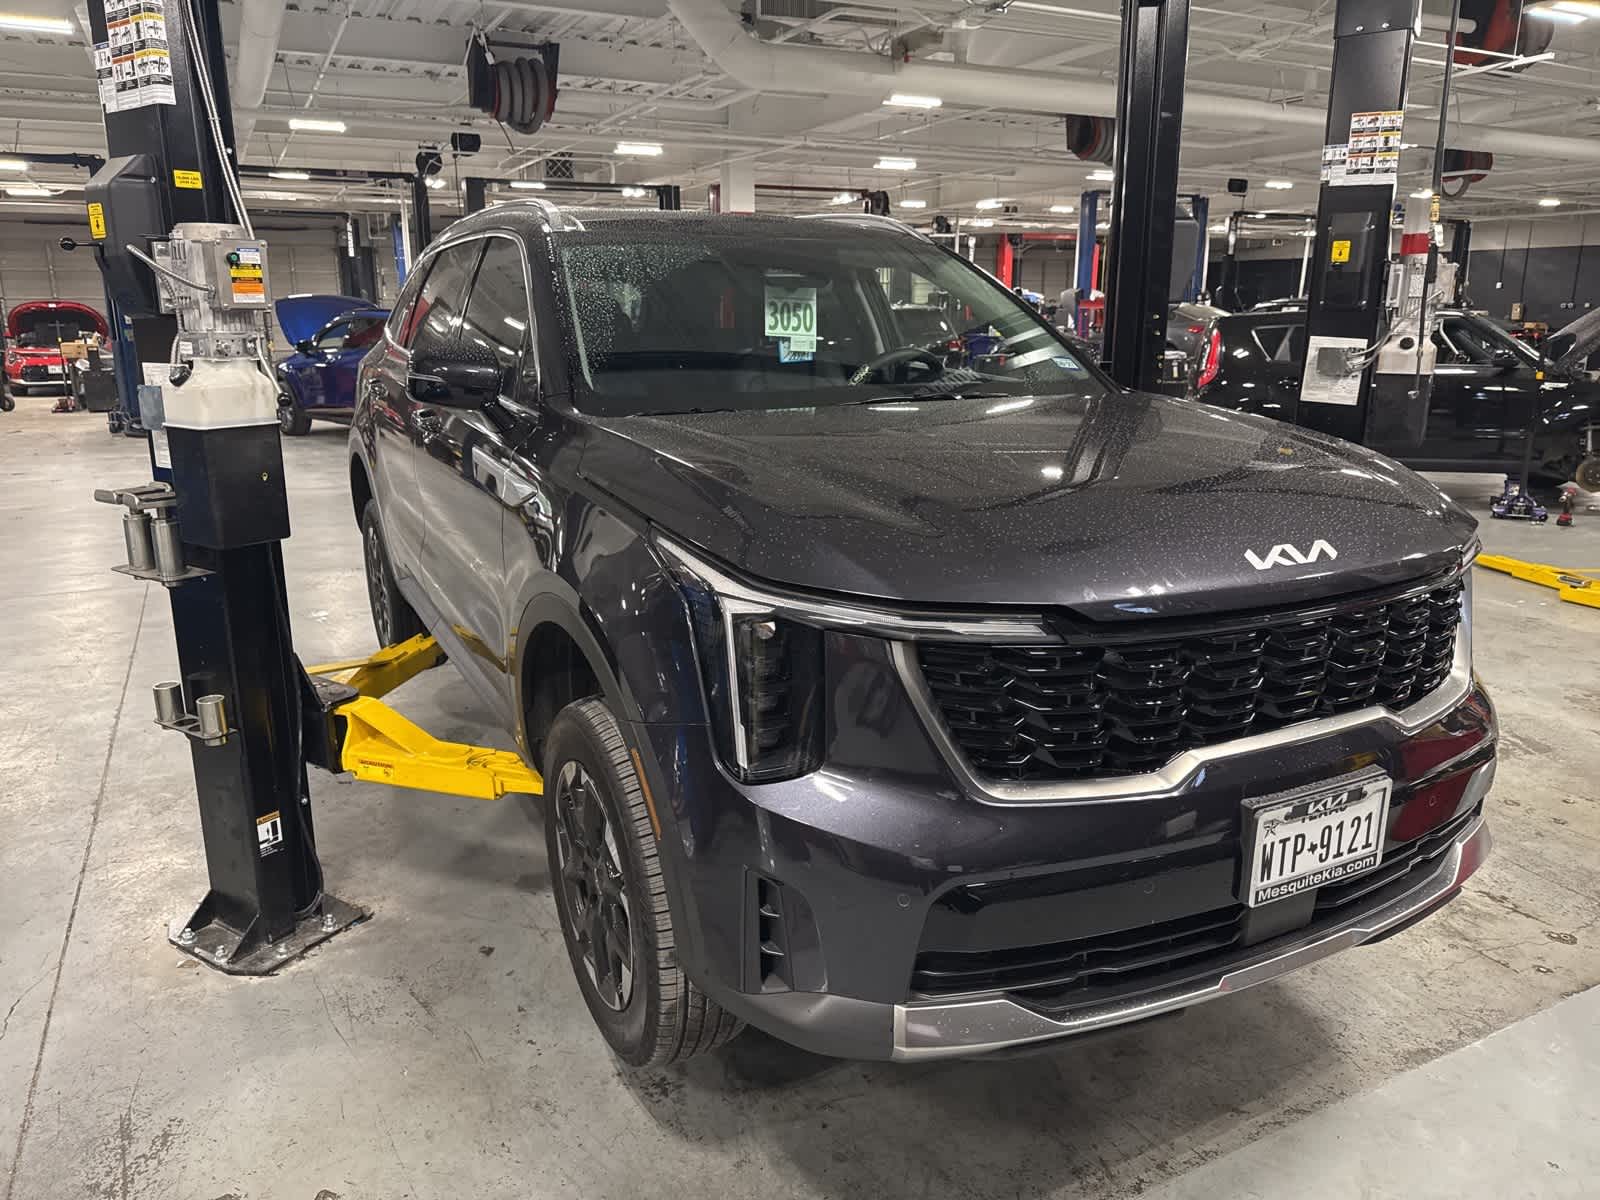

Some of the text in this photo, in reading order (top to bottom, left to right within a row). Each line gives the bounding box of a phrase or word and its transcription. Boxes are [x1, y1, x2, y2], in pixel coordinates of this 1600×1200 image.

[768, 300, 814, 333] 3050
[1243, 539, 1338, 570] KIA
[1308, 793, 1349, 815] KIA
[1257, 856, 1375, 903] MesquiteKia.com
